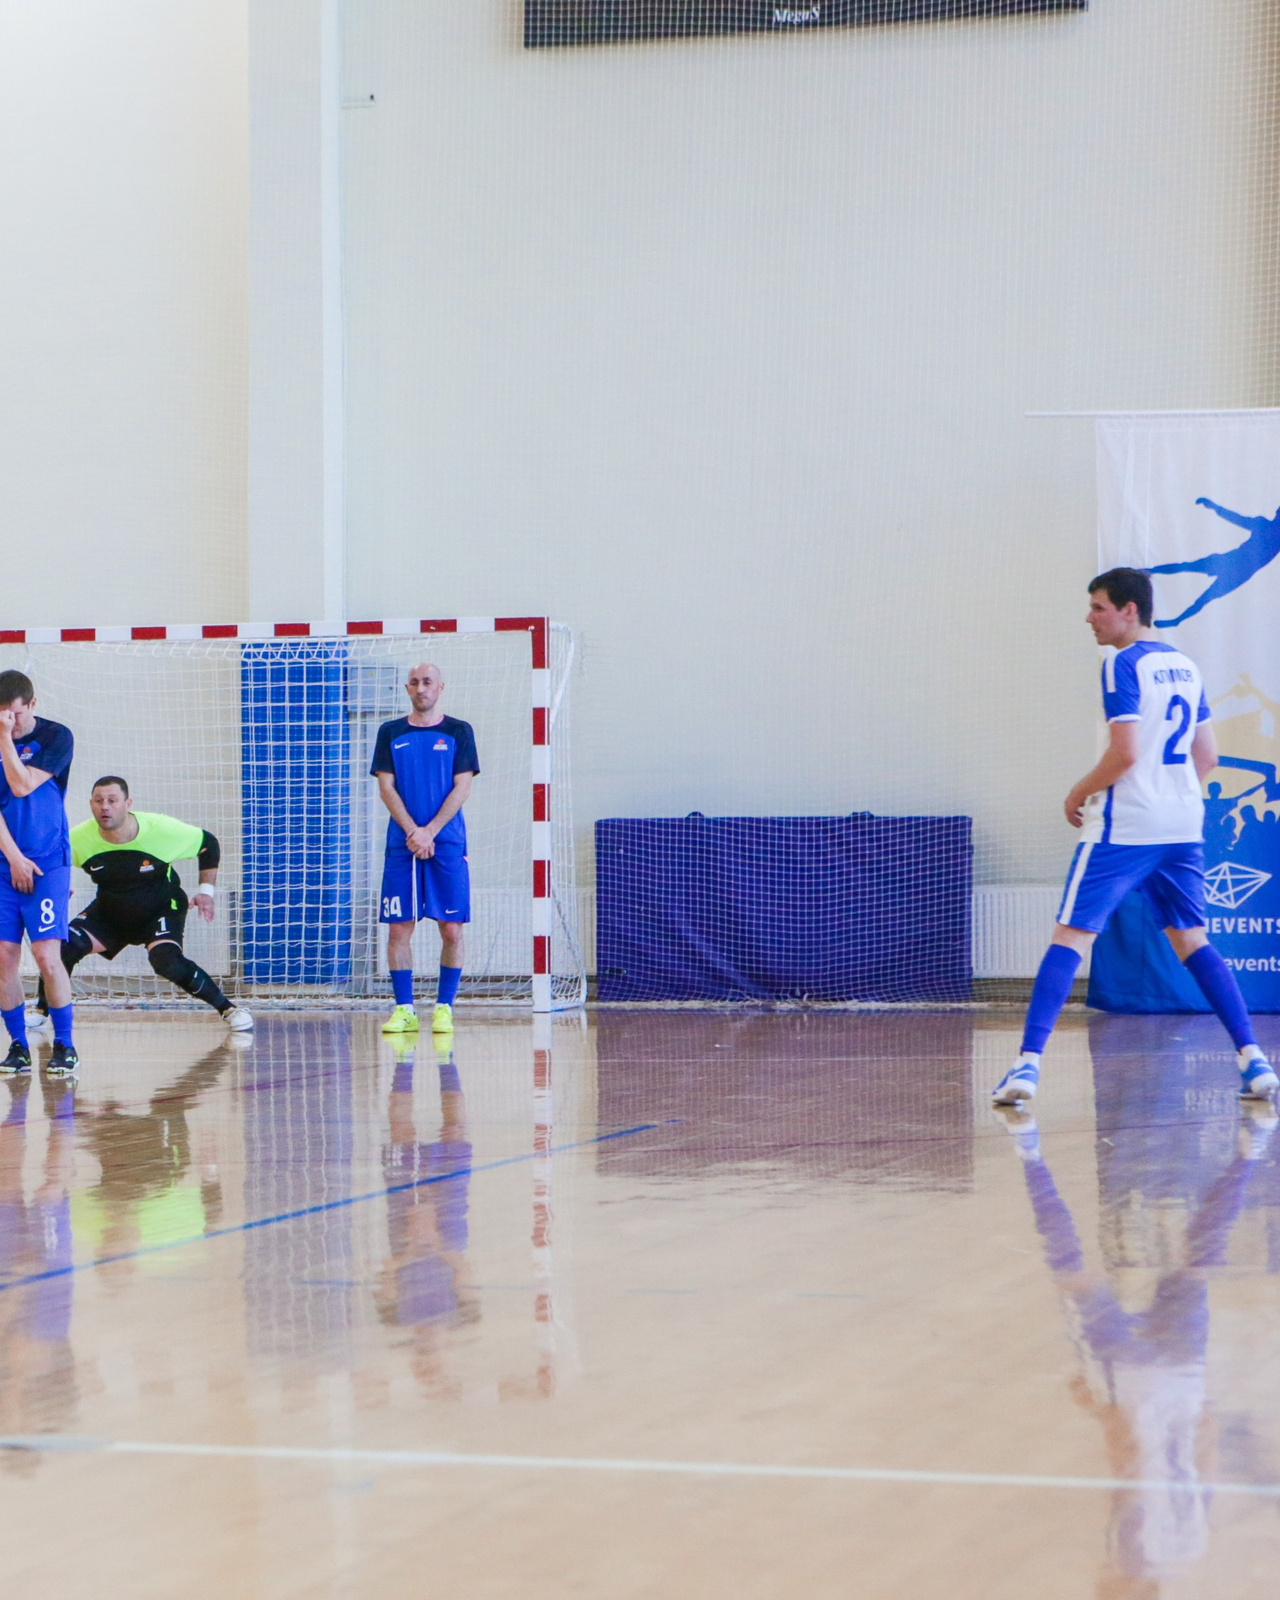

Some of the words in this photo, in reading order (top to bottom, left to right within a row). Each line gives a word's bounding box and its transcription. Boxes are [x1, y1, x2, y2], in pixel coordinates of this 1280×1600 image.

[1162, 694, 1191, 765] 2
[40, 898, 56, 924] 8
[383, 896, 402, 918] 34
[157, 916, 167, 932] 1
